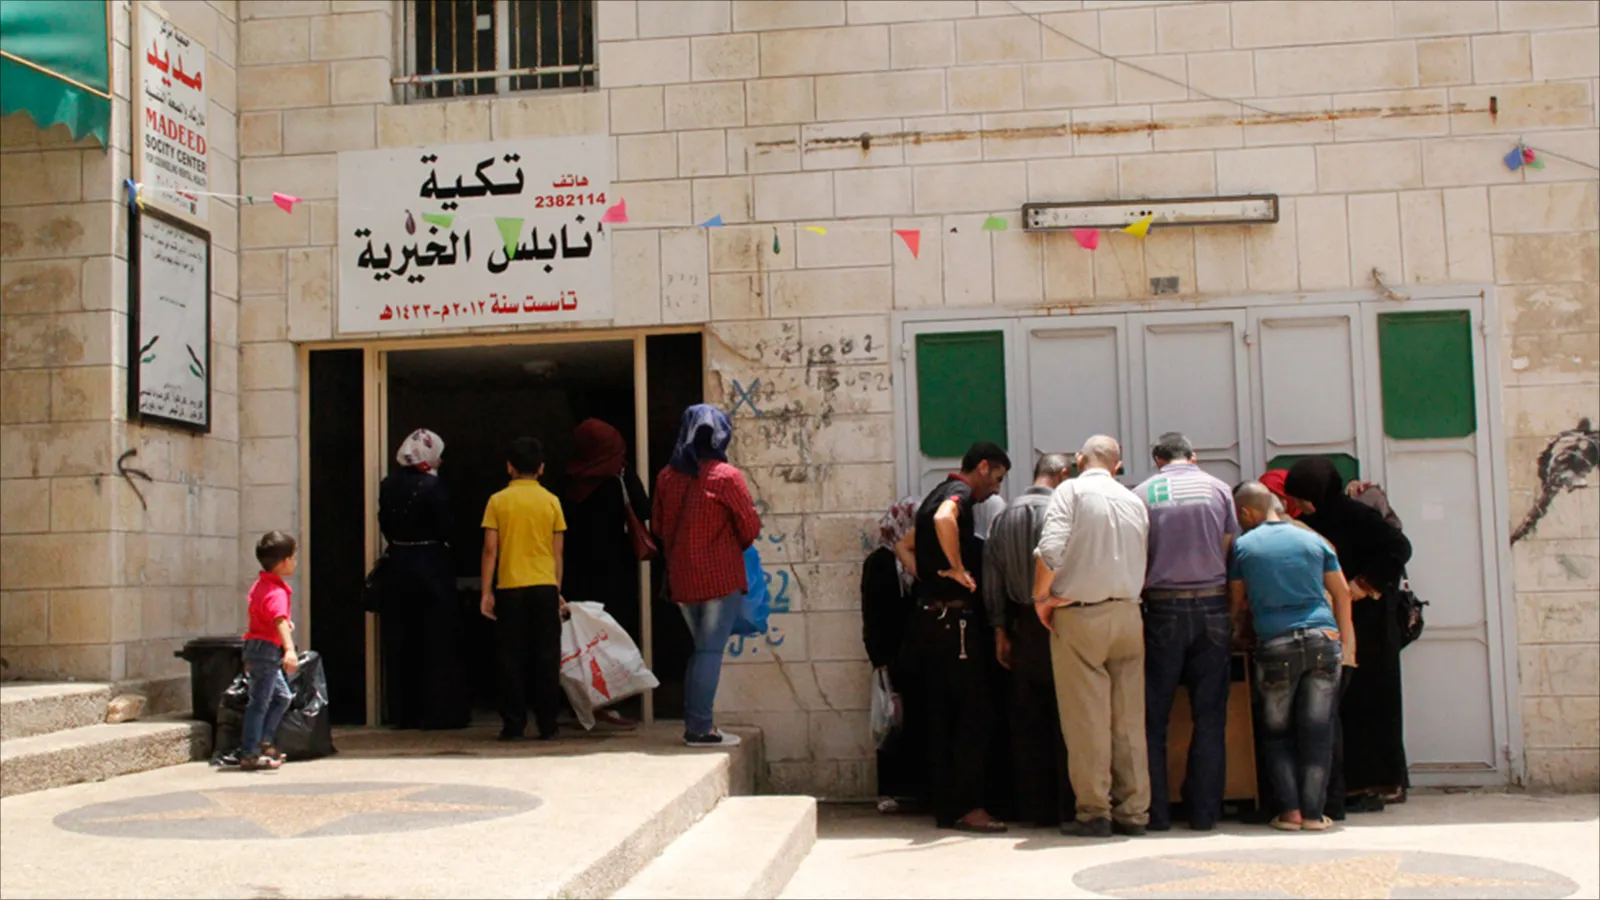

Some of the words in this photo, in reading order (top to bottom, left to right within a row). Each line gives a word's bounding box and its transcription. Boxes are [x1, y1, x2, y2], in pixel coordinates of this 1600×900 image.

[147, 38, 203, 92] مديد
[144, 133, 176, 159] SOCITY
[176, 149, 207, 174] CENTER
[145, 106, 207, 156] MADEED
[419, 153, 525, 211] تكية
[534, 192, 606, 209] 2382114
[552, 174, 589, 188] هاتف
[354, 225, 472, 284] الخيرية
[487, 214, 593, 274] نابلس
[489, 292, 519, 315] سنة
[522, 290, 578, 313] تأسست
